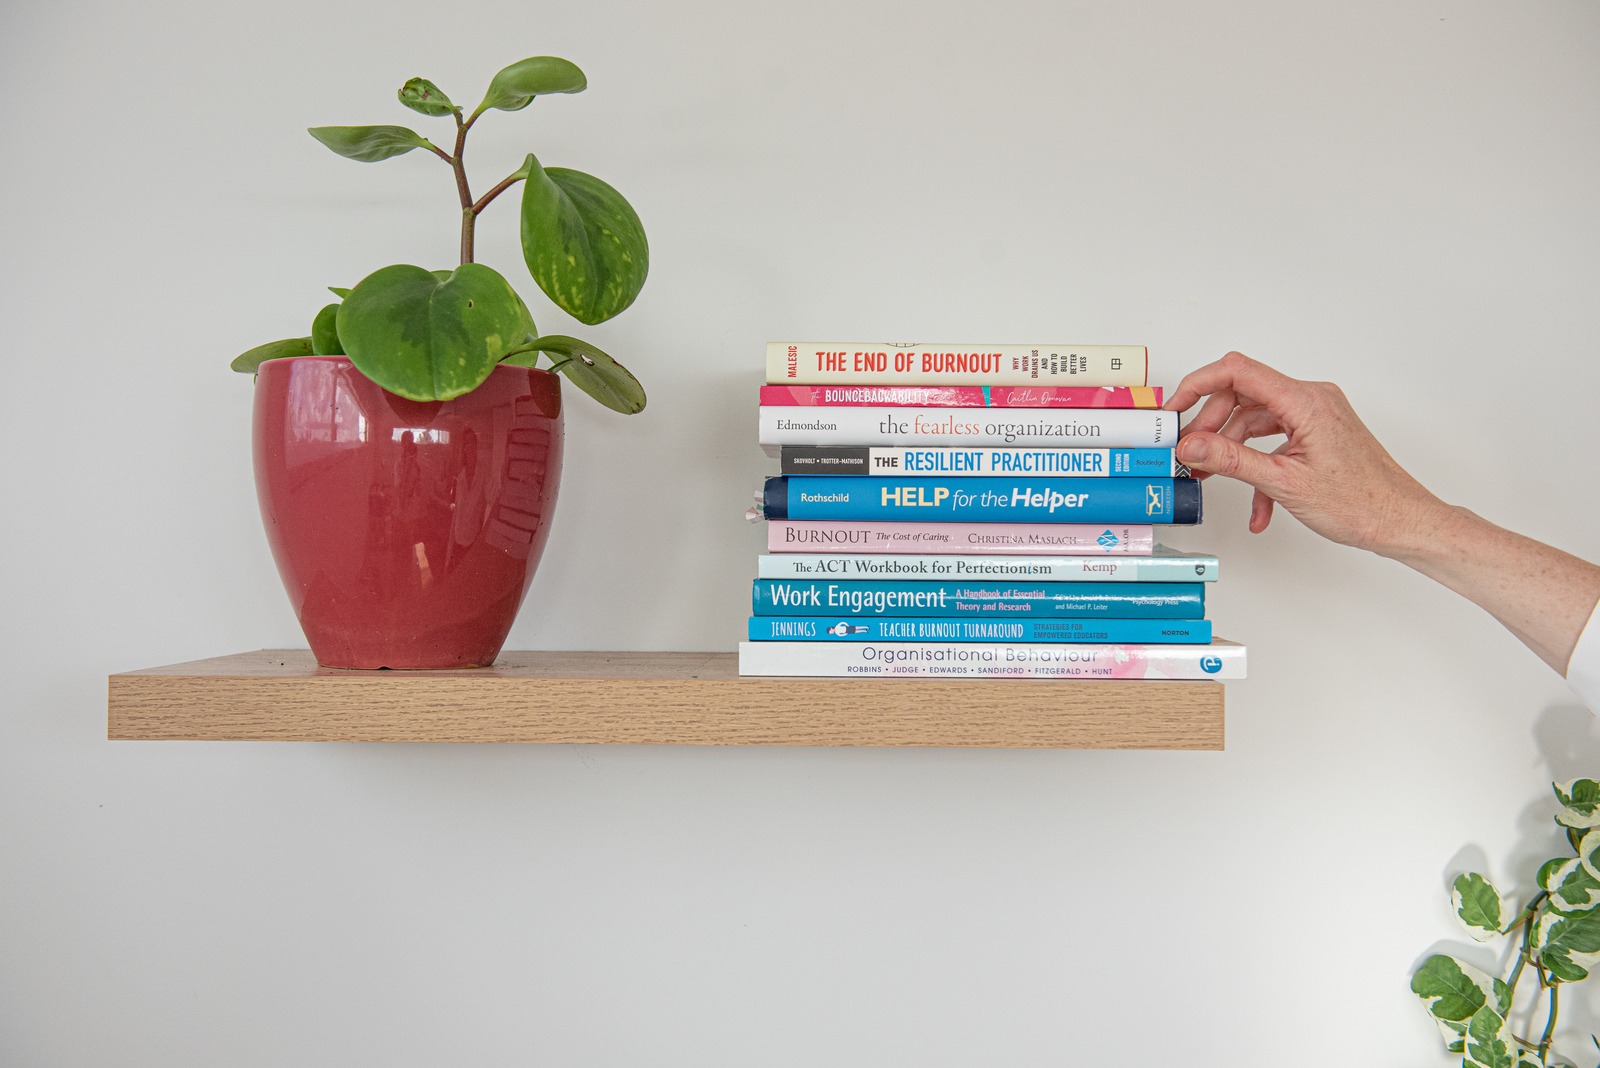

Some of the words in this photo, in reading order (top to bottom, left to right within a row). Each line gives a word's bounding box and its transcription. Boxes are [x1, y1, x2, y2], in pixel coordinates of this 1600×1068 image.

[1031, 349, 1039, 357] US
[1050, 353, 1058, 361] TO
[787, 345, 798, 378] MALESIC
[815, 351, 847, 372] THE
[854, 352, 888, 372] END
[894, 352, 915, 373] OF
[921, 352, 1003, 373] BURNOUT
[1031, 358, 1039, 379] DRAINS
[1050, 362, 1058, 375] HOW
[1060, 355, 1068, 373] BUILD
[1069, 353, 1077, 375] BETTER
[1079, 356, 1087, 372] LIVES
[824, 388, 930, 403] BOUNCEBACKABILITY
[776, 419, 838, 431] Edmondson
[879, 414, 909, 435] the
[914, 414, 981, 436] fearless
[985, 419, 1102, 443] organization
[1154, 416, 1163, 444] WILEY
[874, 456, 899, 468] THE
[904, 451, 984, 472] RESILIENT
[991, 451, 1103, 473] PRACTITIONER
[1114, 453, 1122, 473] SECOND
[1136, 459, 1165, 468] Routledge
[800, 492, 850, 503] Rothschild
[880, 486, 950, 507] HELP
[952, 489, 977, 511] for
[980, 489, 1009, 508] the
[1011, 487, 1089, 514] Helper
[785, 526, 871, 544] BURNOUT
[876, 532, 891, 541] The
[892, 532, 911, 542] Cost
[912, 532, 923, 543] of
[922, 532, 950, 544] Caring
[967, 533, 1025, 544] CHRISTINA
[1028, 534, 1077, 545] MASLACH
[793, 561, 812, 573] The
[815, 559, 851, 574] ACT
[854, 559, 928, 575] Workbook
[932, 559, 953, 575] for
[956, 560, 1053, 576] Perfectionism
[1082, 560, 1118, 576] Kemp
[770, 584, 821, 607] Work
[828, 585, 947, 613] Engagement
[955, 589, 962, 598] A
[964, 589, 1001, 599] Handbook
[1003, 589, 1012, 599] of
[1013, 590, 1045, 599] Essential
[956, 602, 979, 613] Theory
[982, 602, 996, 611] and
[999, 602, 1031, 613] Research
[771, 622, 816, 637] JENNINGS
[879, 622, 916, 637] TEACHER
[919, 623, 960, 638] BURNOUT
[963, 623, 1024, 639] TURNAROUND
[1034, 623, 1069, 632] STRATEGIES
[1071, 623, 1084, 632] FOR
[1034, 632, 1071, 640] EMPOWERED
[1073, 632, 1108, 641] EDUCATORS
[862, 646, 998, 664] Organisational
[1005, 648, 1098, 663] Behaviour
[847, 666, 882, 674] ROBBINS
[892, 666, 919, 674] JUDGE
[929, 667, 968, 675] EDWARDS
[977, 667, 1025, 675] SANDIFORD
[1035, 667, 1081, 676] FITZGERALD
[1092, 668, 1113, 676] HUNT
